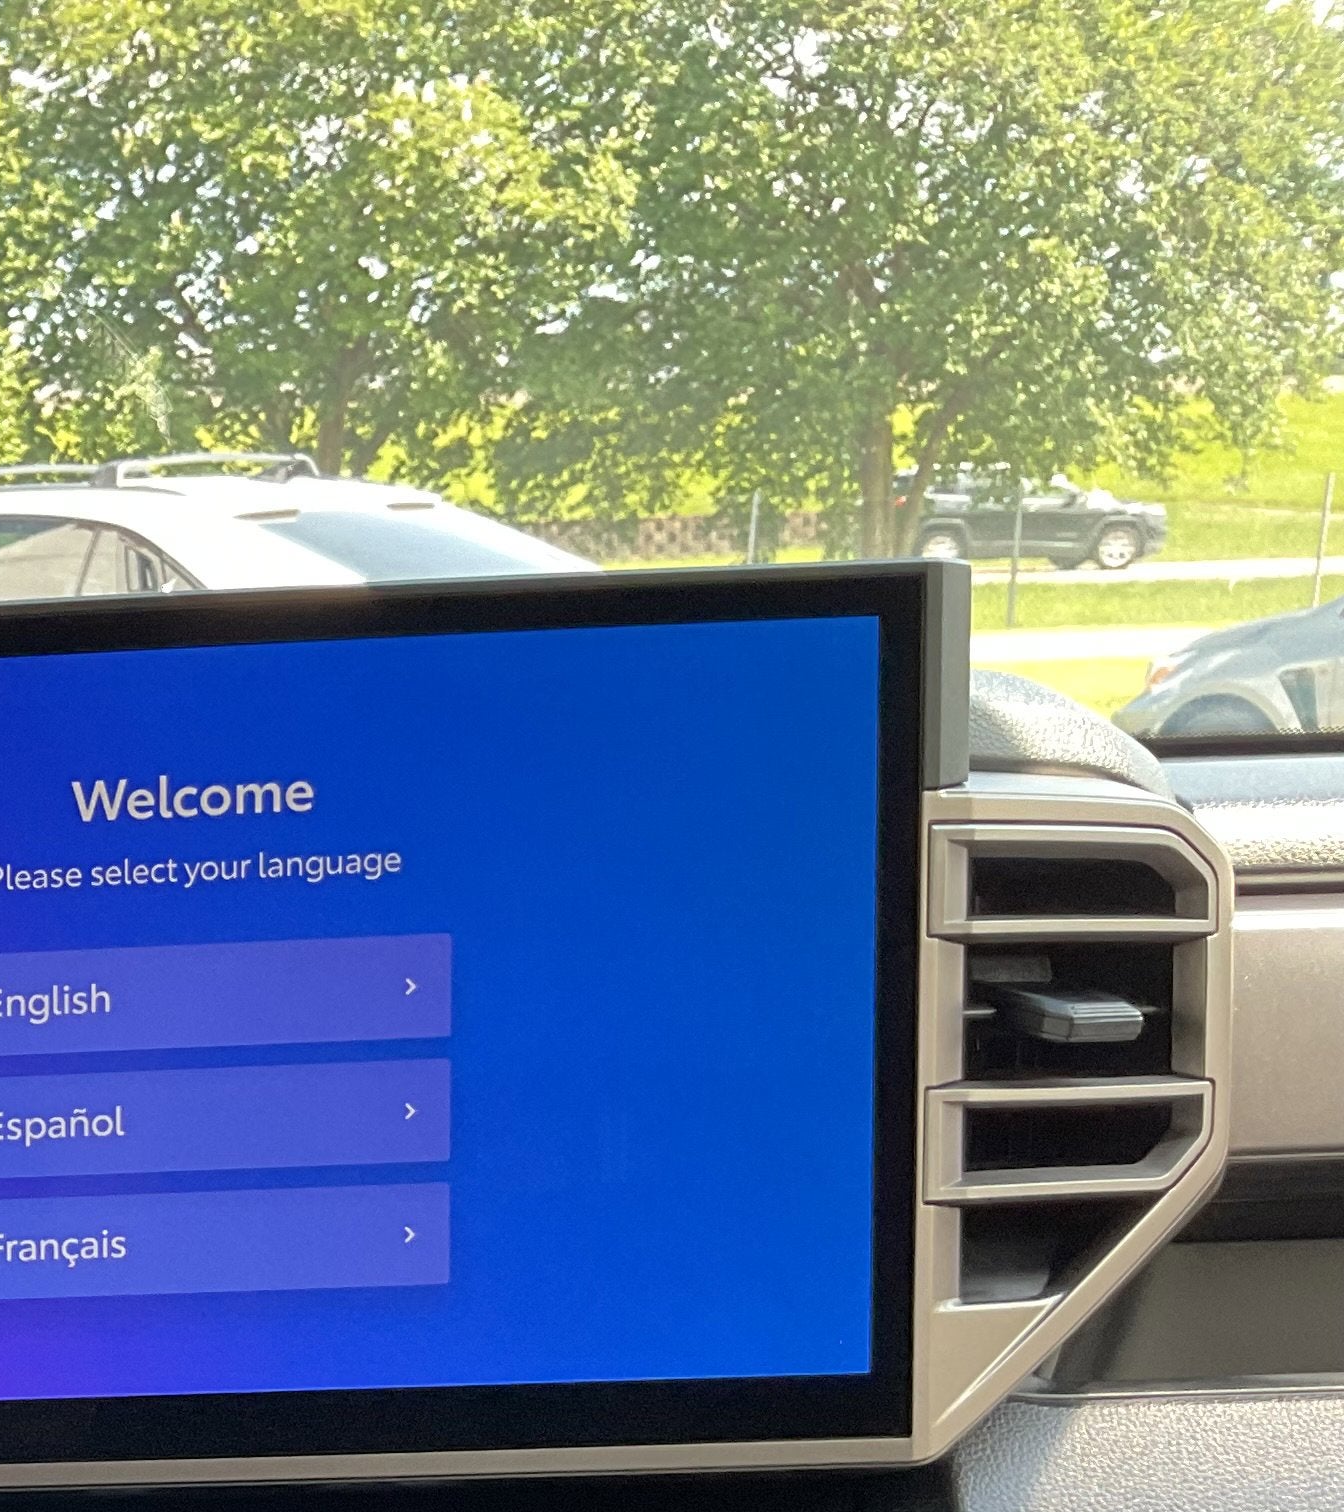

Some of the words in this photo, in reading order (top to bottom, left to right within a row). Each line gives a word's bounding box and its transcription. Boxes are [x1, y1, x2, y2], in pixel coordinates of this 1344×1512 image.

[71, 774, 315, 823] Welcome
[91, 857, 178, 886] select
[184, 856, 251, 888] your
[258, 848, 403, 883] language
